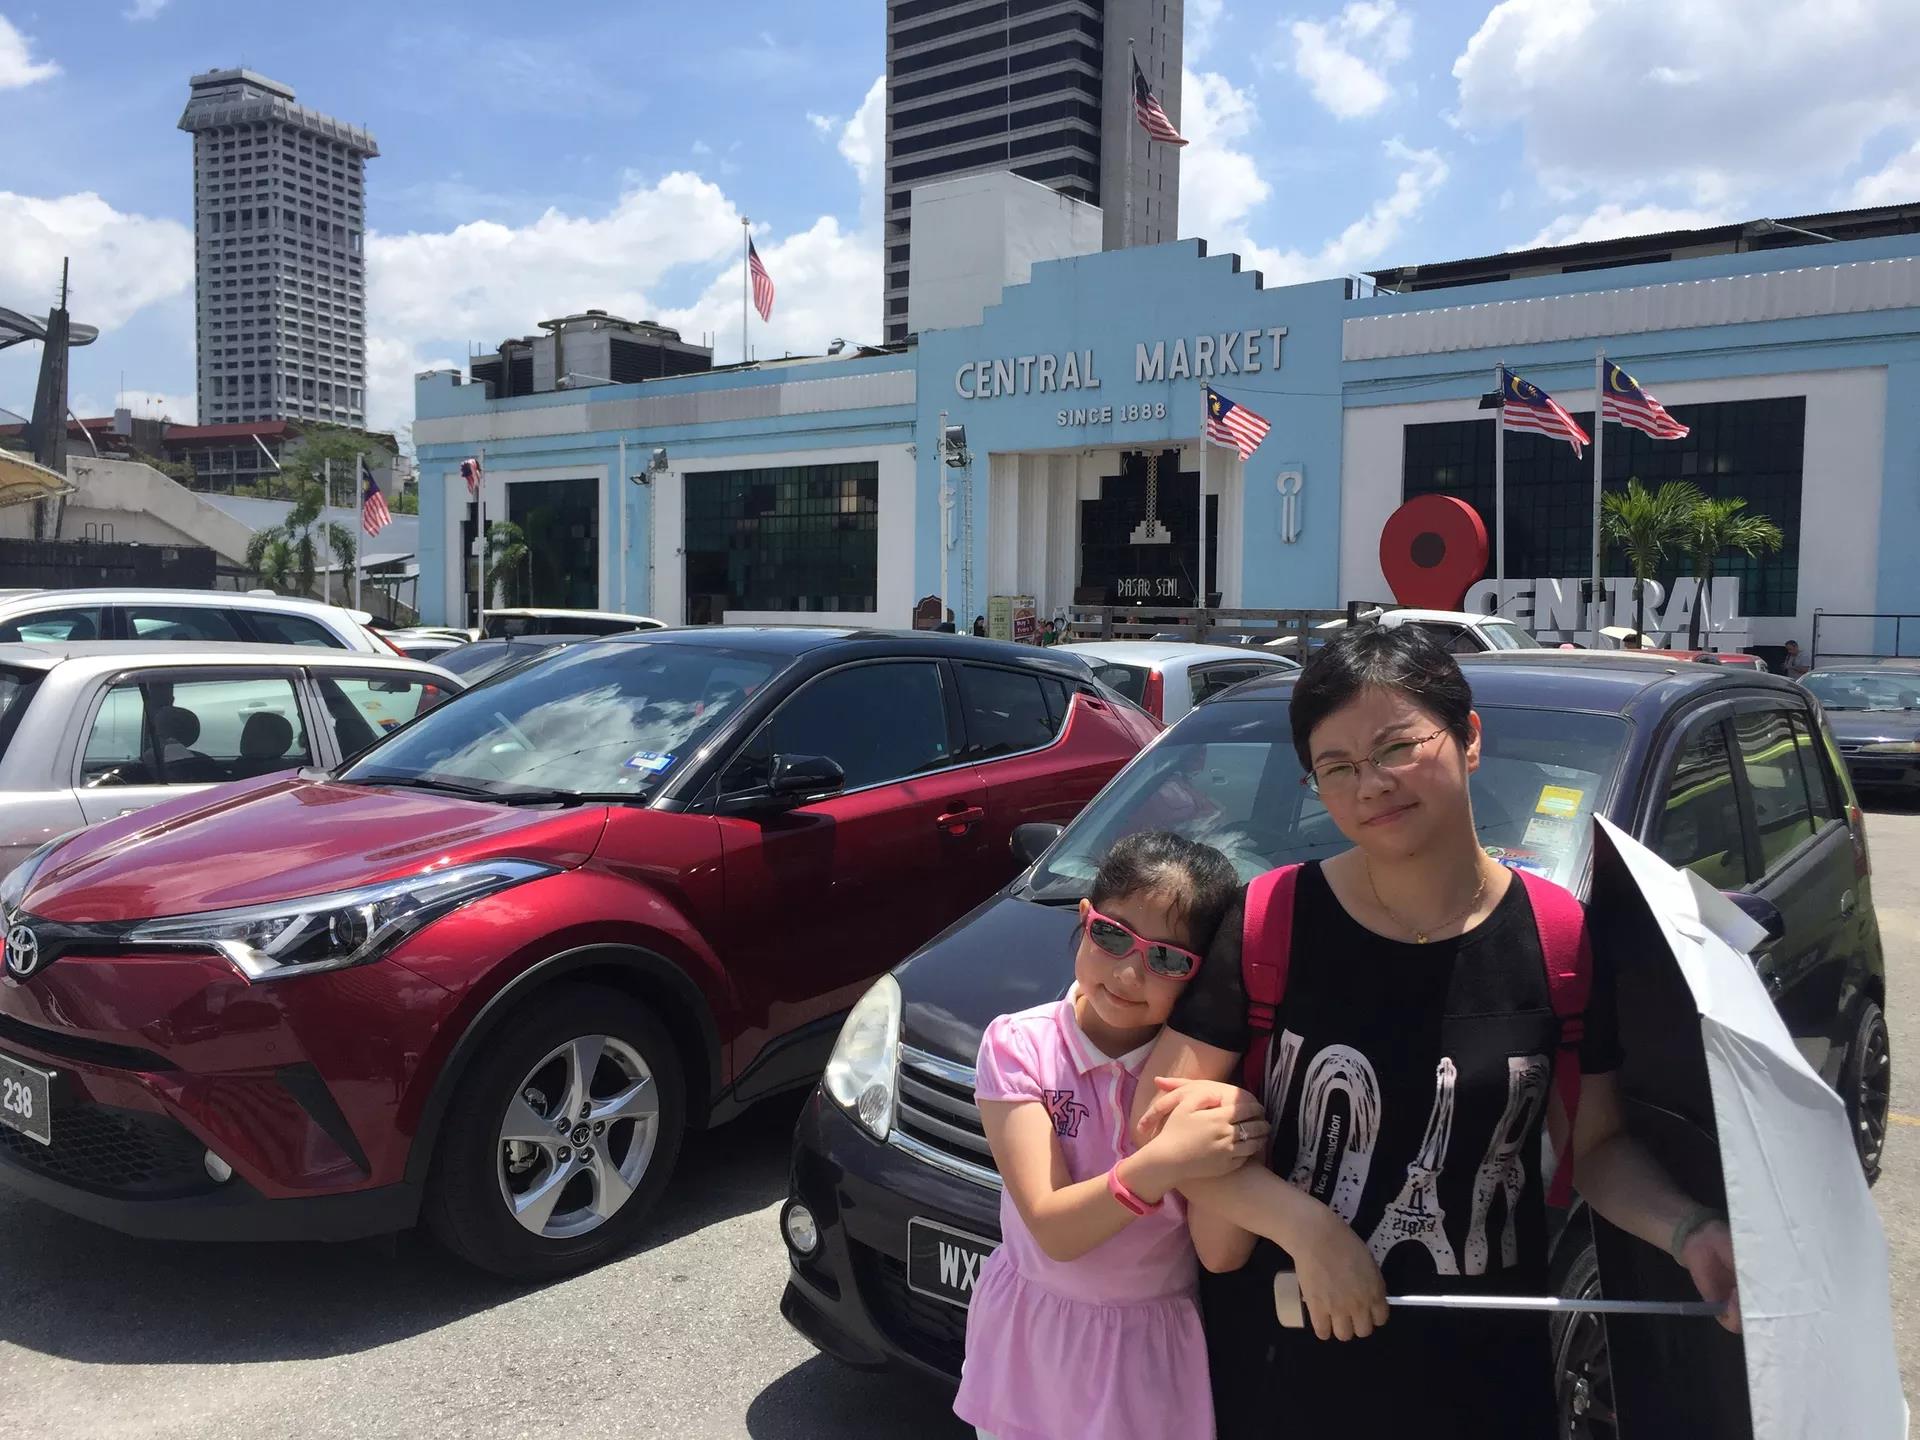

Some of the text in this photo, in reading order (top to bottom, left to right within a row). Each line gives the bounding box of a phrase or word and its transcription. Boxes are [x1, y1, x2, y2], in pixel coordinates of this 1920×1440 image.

[955, 326, 1288, 399] CENTRAL MARKET
[1057, 402, 1166, 427] SINCE 1888
[1117, 578, 1178, 597] PASAR SENI
[3, 1077, 33, 1118] 238
